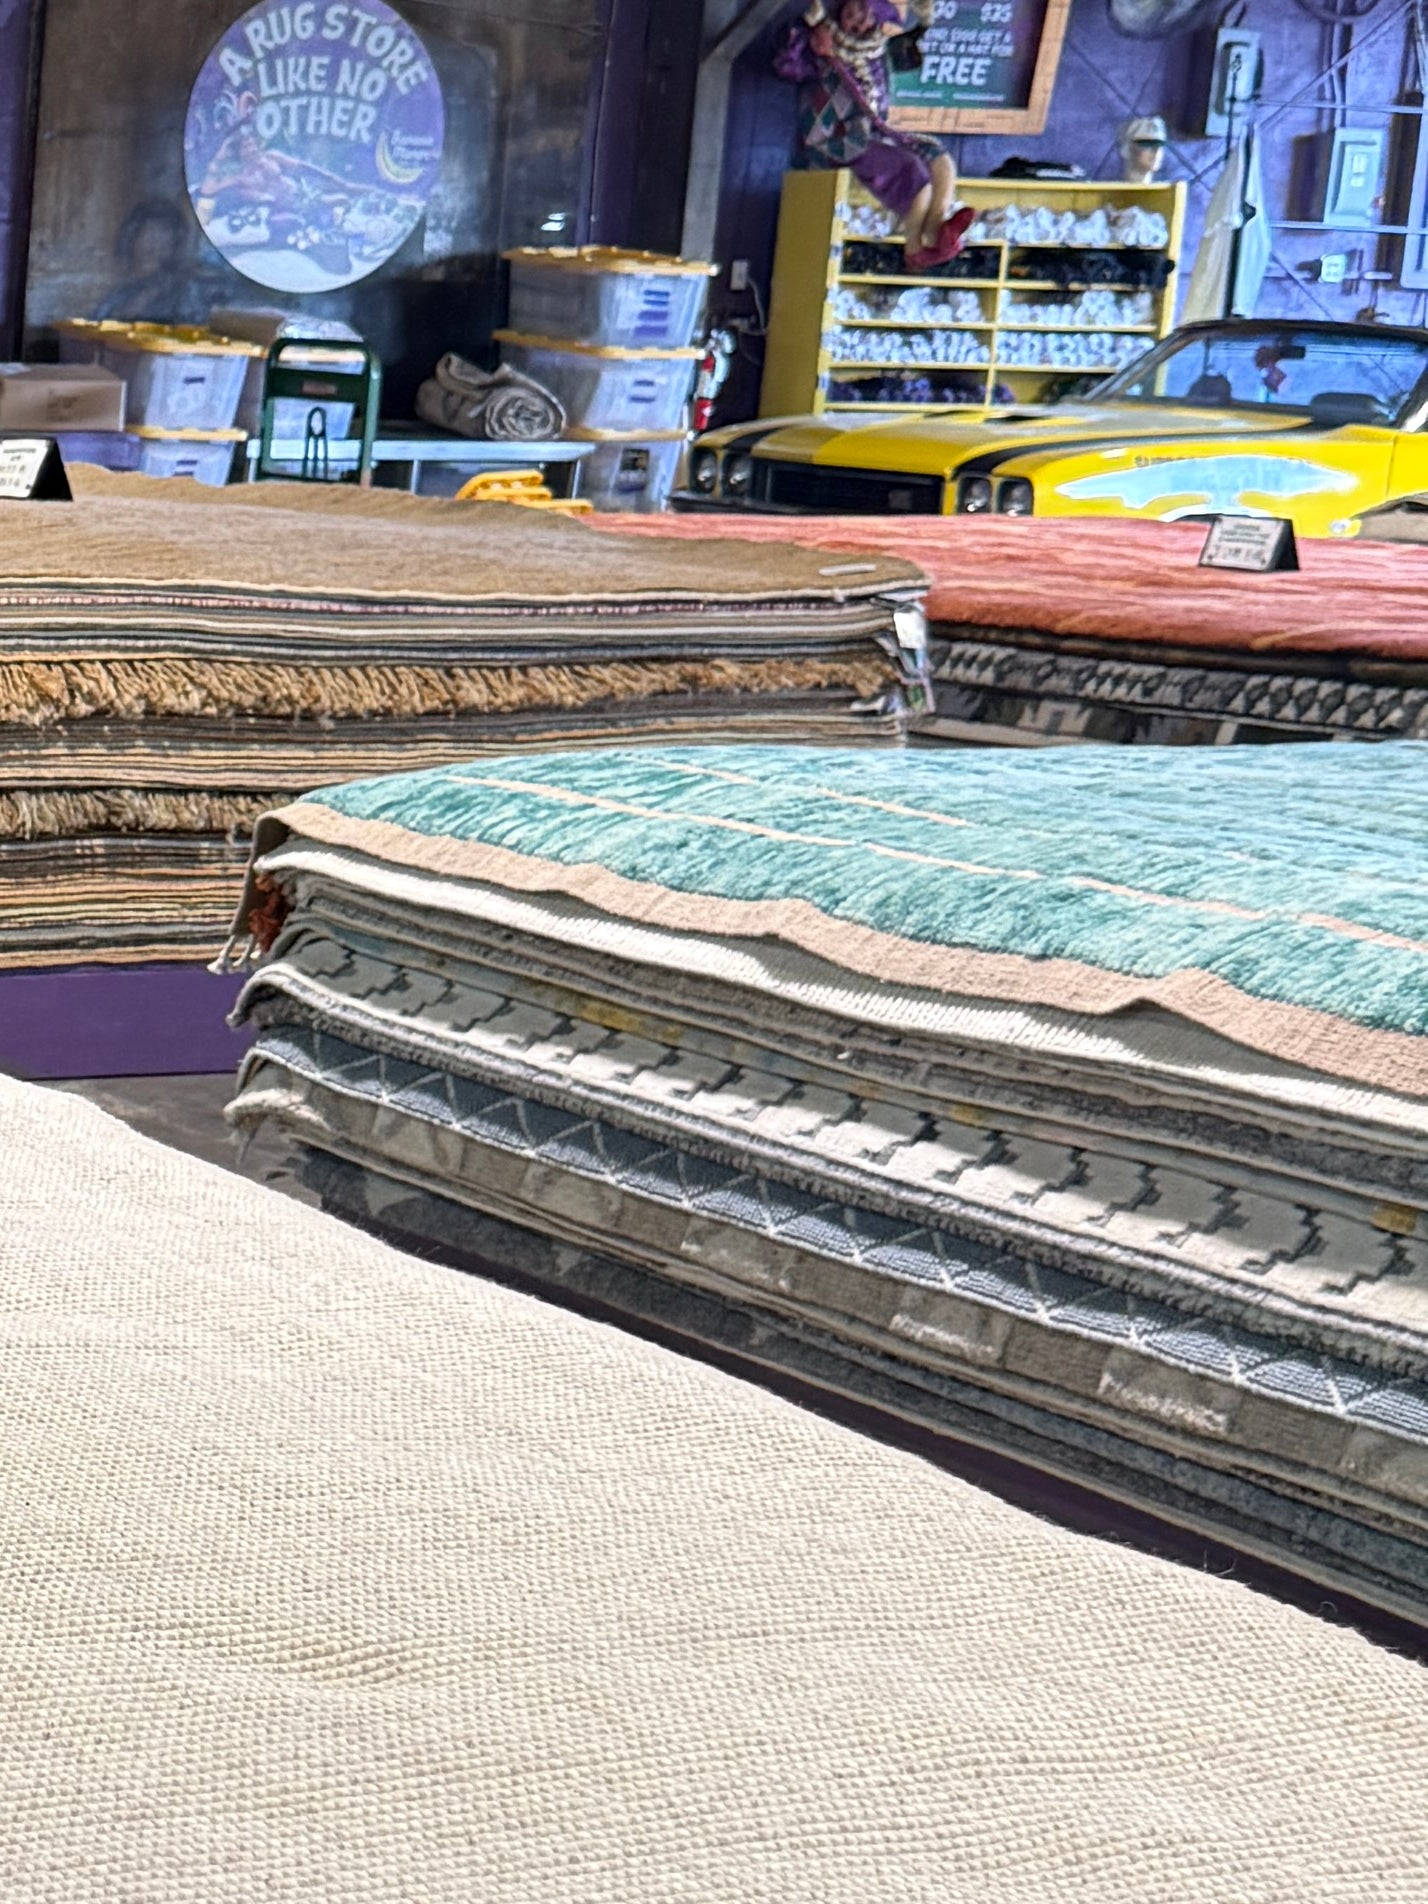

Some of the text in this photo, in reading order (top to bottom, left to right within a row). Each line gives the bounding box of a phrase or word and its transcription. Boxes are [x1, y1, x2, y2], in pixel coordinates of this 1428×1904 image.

[218, 2, 430, 94] A RUG STORE
[920, 55, 993, 86] FREE
[257, 55, 387, 100] LIKE NO
[256, 97, 376, 143] OTHER
